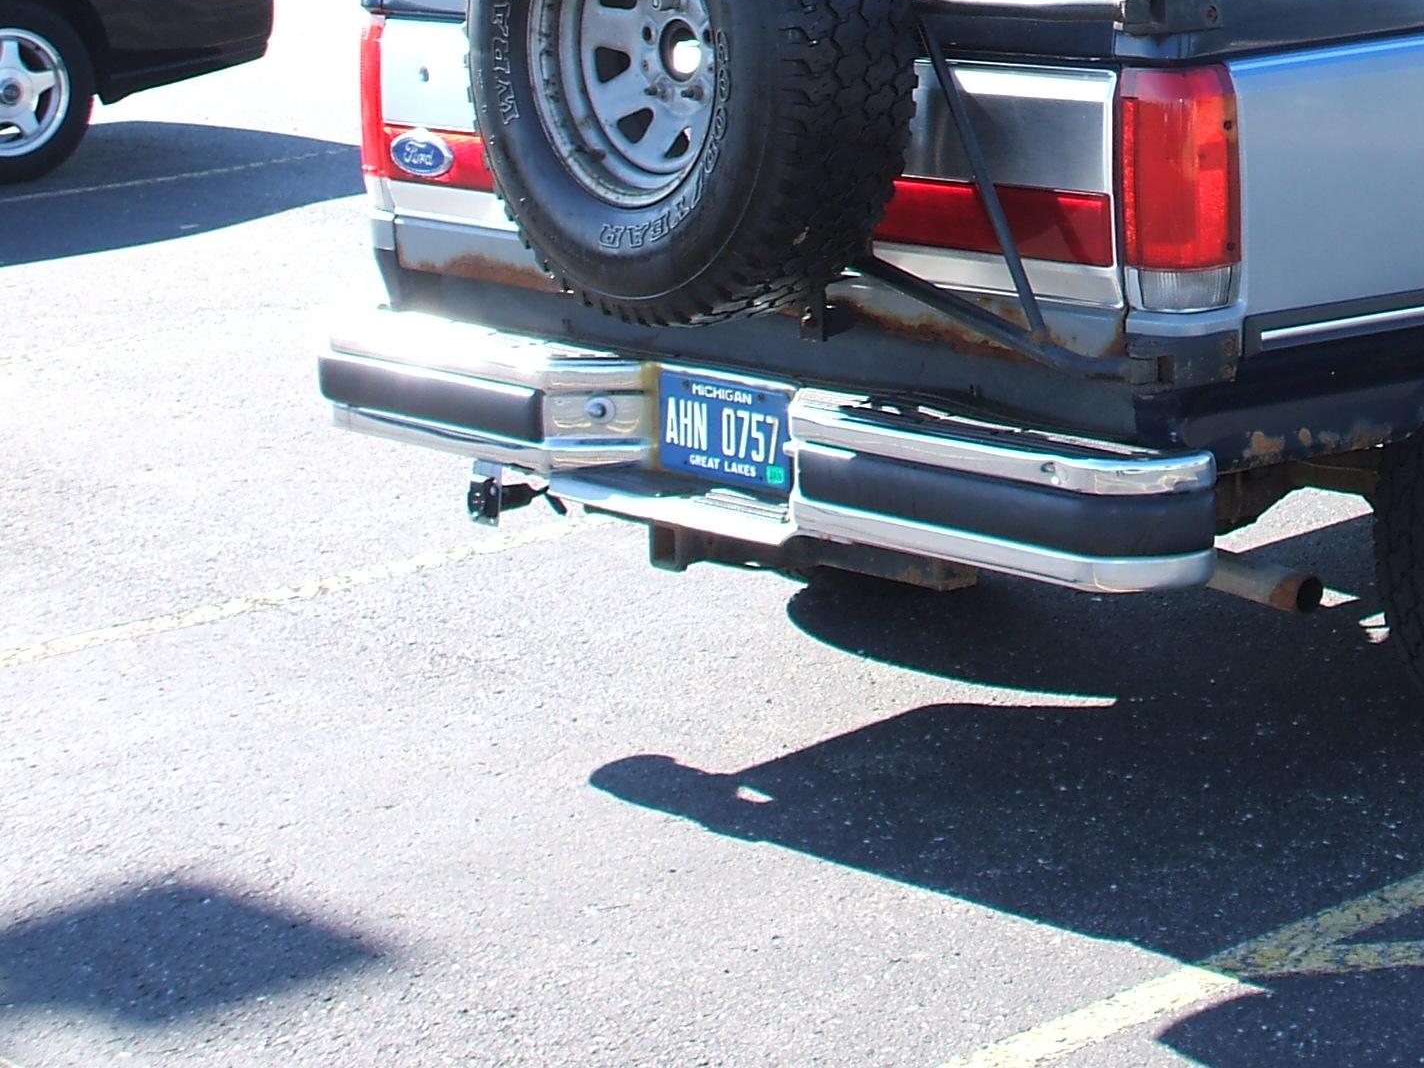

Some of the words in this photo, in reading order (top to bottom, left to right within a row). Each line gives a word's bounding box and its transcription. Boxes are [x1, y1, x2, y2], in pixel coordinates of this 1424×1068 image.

[599, 27, 731, 249] GOODYEAR
[403, 140, 435, 166] Ford
[691, 383, 753, 405] MICHIGAN
[665, 396, 708, 451] AHN
[721, 407, 779, 465] 0757
[689, 454, 721, 470] GREAT
[724, 461, 757, 478] LAKES
